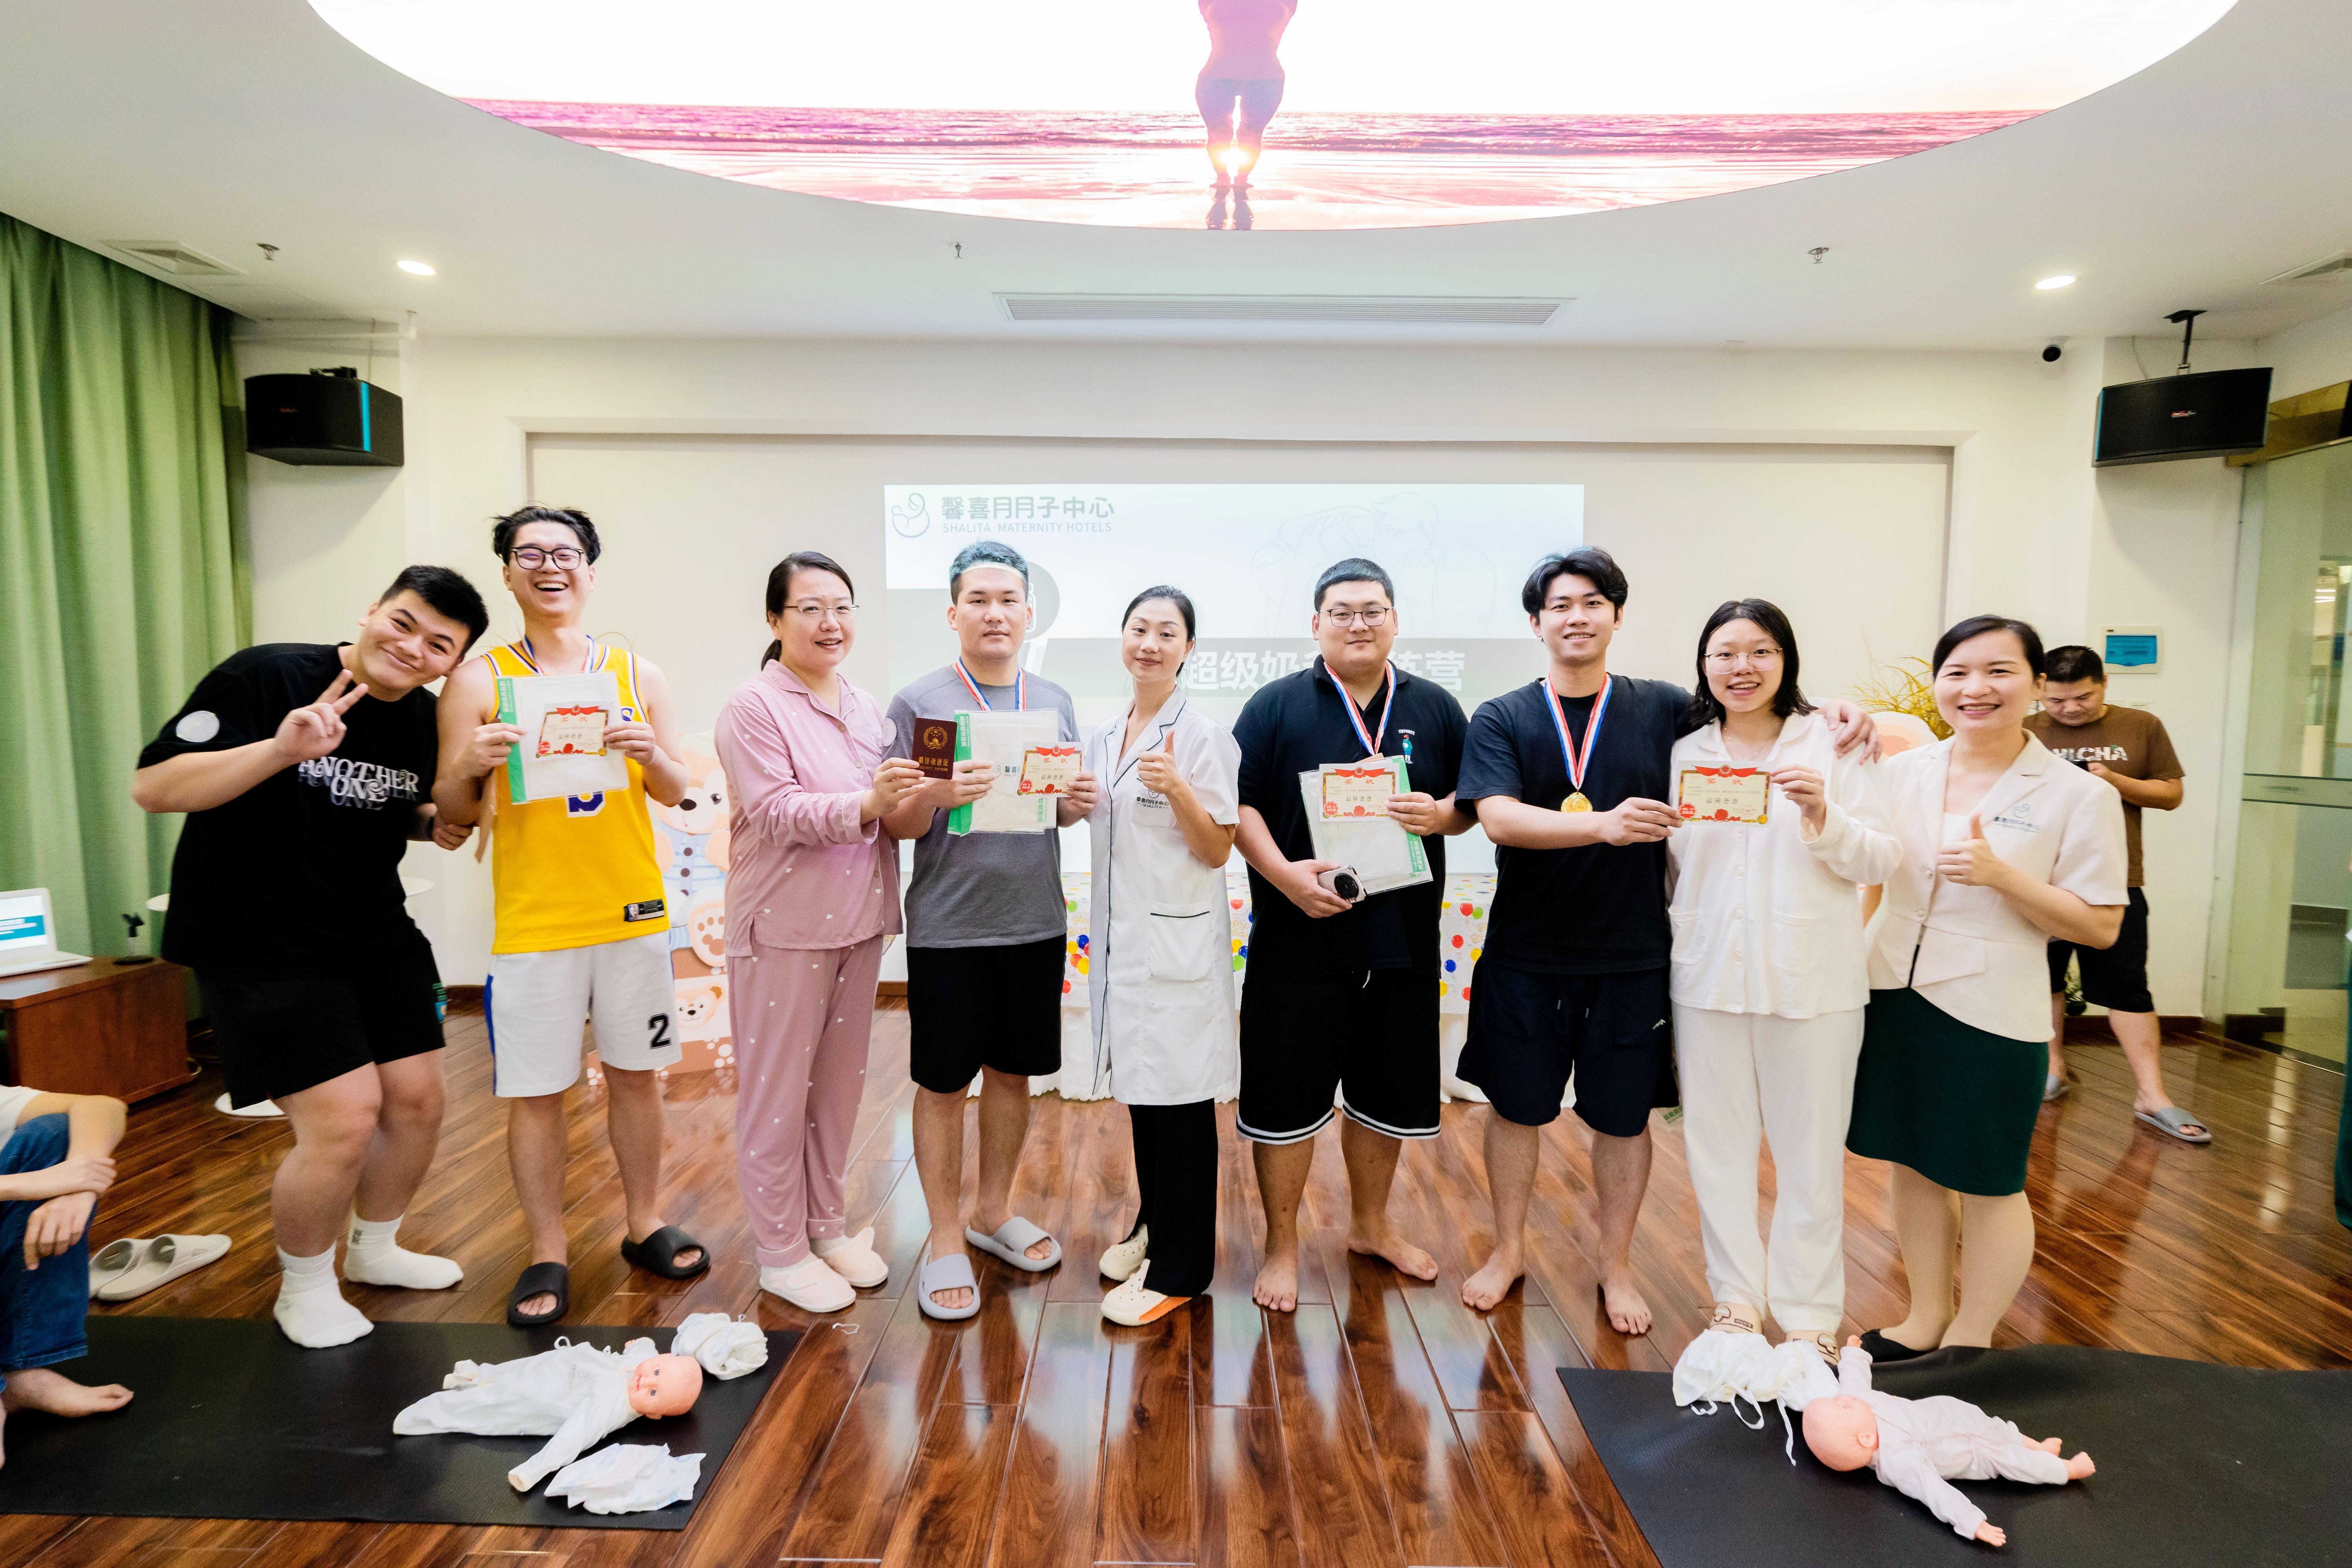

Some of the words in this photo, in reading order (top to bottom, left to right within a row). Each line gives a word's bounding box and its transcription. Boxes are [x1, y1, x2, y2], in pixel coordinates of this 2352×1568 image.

[942, 496, 1114, 520] 馨喜月月子中心
[943, 523, 991, 533] SHALITA
[998, 523, 1062, 532] MATERNITY
[1067, 522, 1112, 532] HOTELS
[1184, 650, 1466, 691] 超级奶练营
[298, 756, 420, 793] ANOTHER
[330, 776, 388, 802] ONE
[648, 1013, 671, 1049] 2
